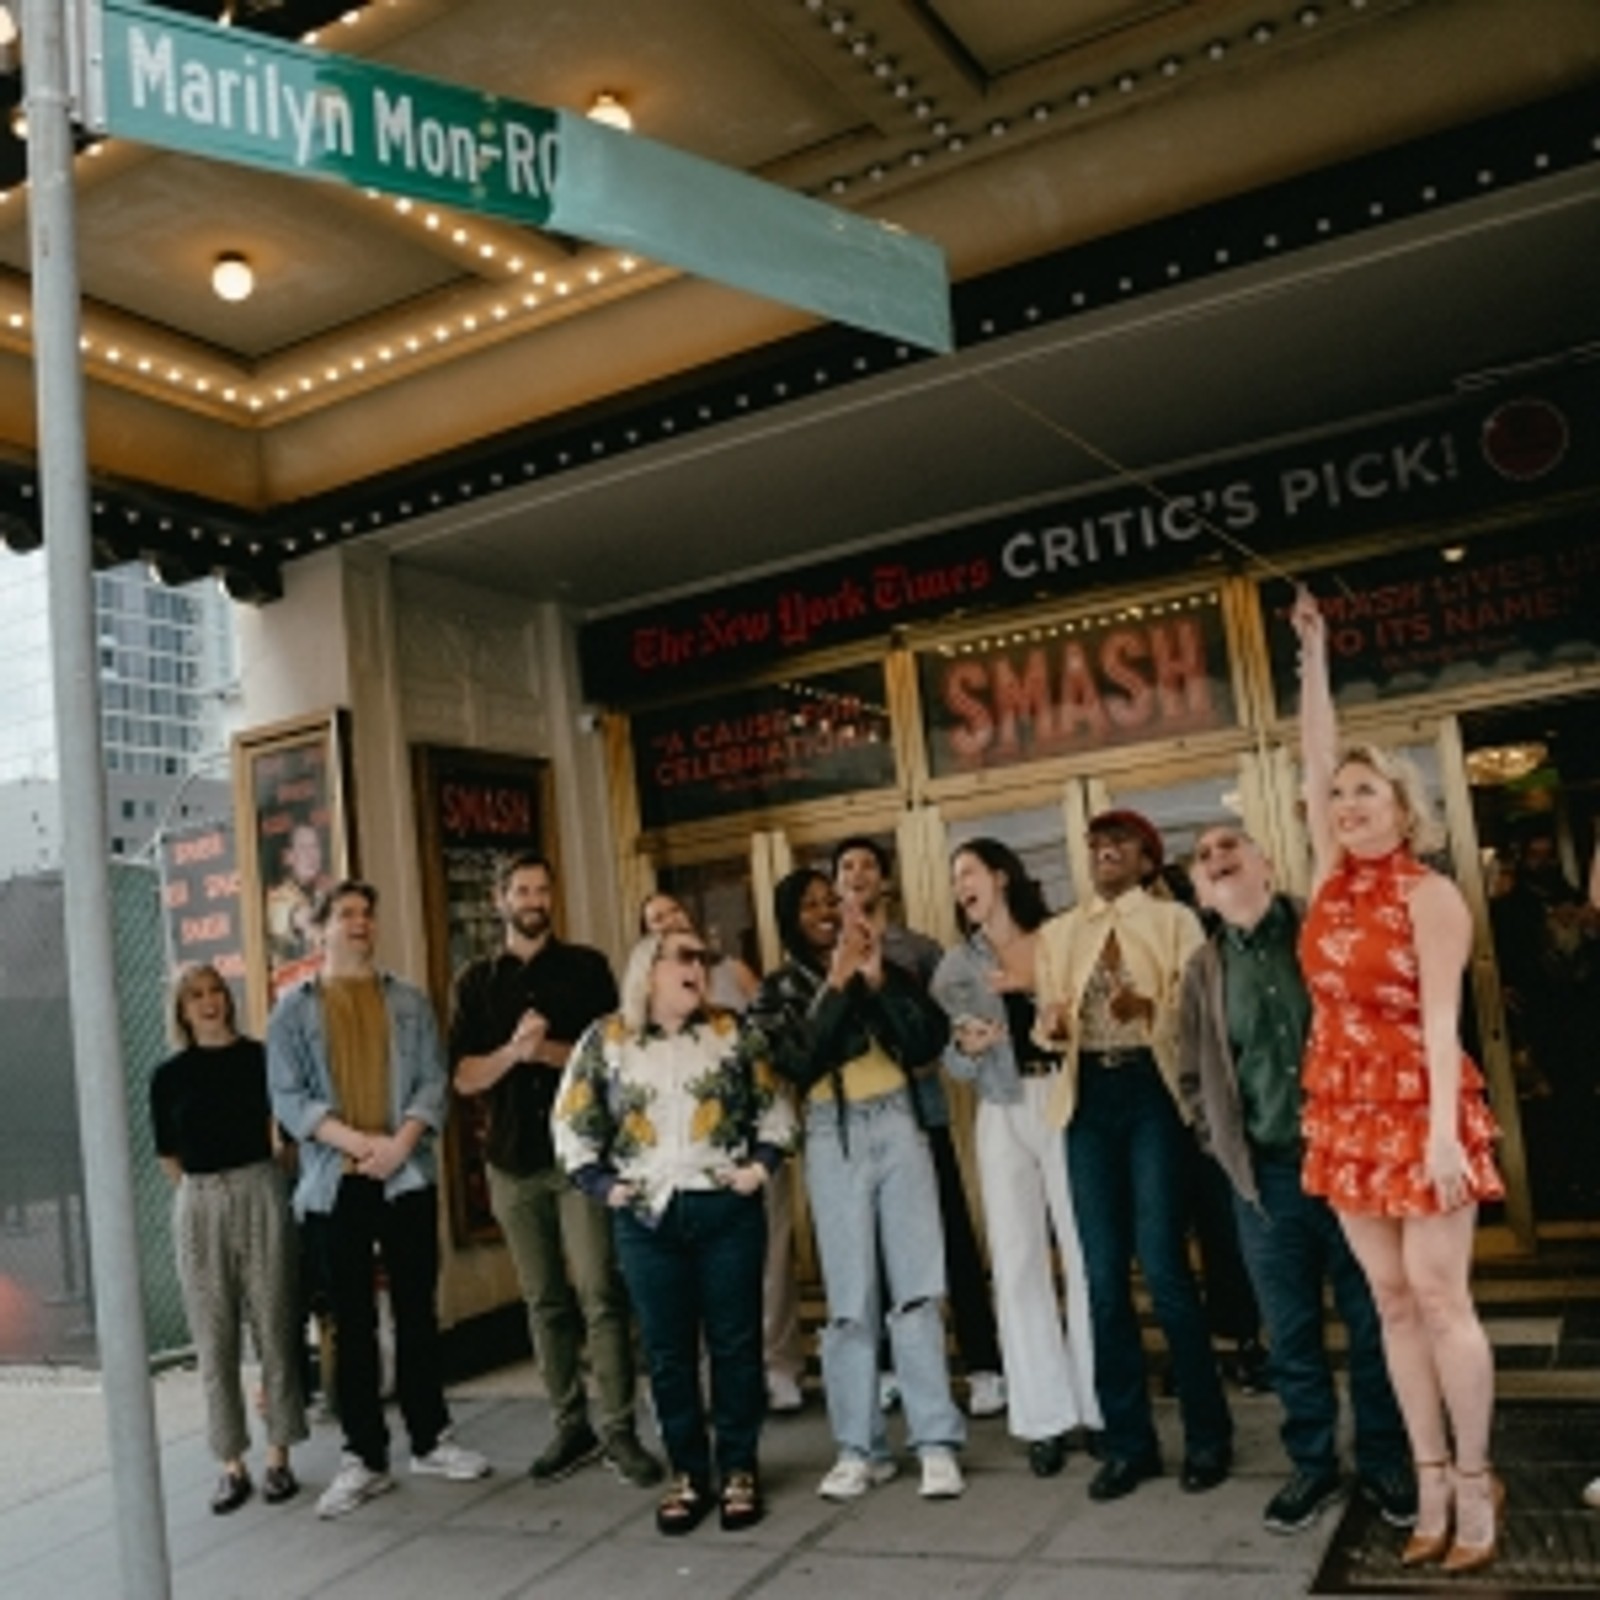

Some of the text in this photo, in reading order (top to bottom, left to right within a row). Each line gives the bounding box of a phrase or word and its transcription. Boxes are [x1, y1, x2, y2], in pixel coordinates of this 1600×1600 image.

[128, 27, 354, 166] Marilyn
[631, 431, 1459, 672] The New York Times CRITIC'S PICK!
[943, 618, 1211, 757] SMASH
[1376, 612, 1432, 648] ITS
